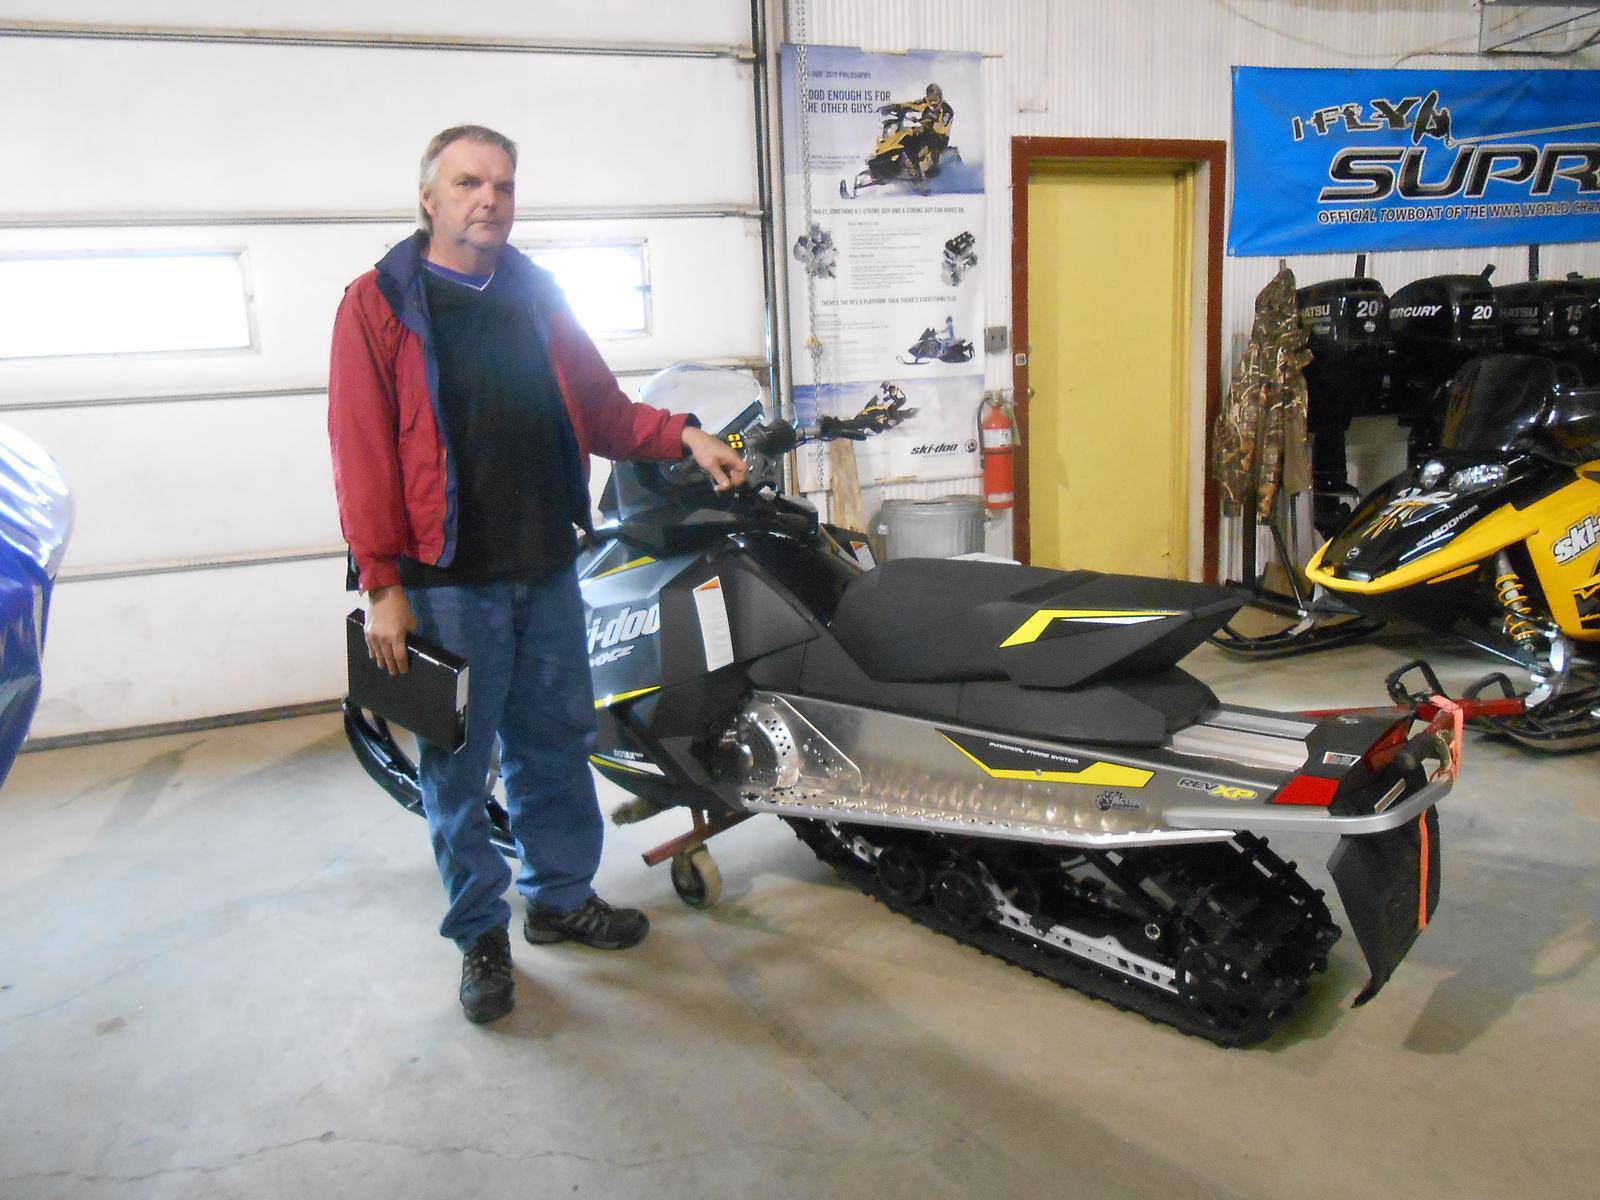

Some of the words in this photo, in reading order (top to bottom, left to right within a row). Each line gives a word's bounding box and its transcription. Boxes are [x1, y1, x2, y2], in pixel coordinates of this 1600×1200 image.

[840, 71, 872, 79] PHILOSOPHY
[828, 90, 862, 101] ENOUGH
[865, 91, 873, 101] IS
[876, 91, 891, 101] FOR
[821, 103, 848, 113] OTHER
[1306, 97, 1422, 134] FLY
[1318, 144, 1600, 203] SUPR
[1318, 208, 1377, 224] OFFICIAL
[1380, 205, 1442, 221] TOWBOAT
[1445, 205, 1462, 220] OF
[1464, 204, 1487, 219] THE
[1489, 203, 1521, 218] WWA
[1524, 201, 1571, 216] WORLD
[1356, 301, 1379, 318] 20
[1389, 305, 1442, 319] ERCURY
[1471, 305, 1493, 320] 20
[1567, 305, 1583, 321] 15
[1026, 749, 1051, 759] FRAME
[1050, 754, 1079, 764] SYSTEM
